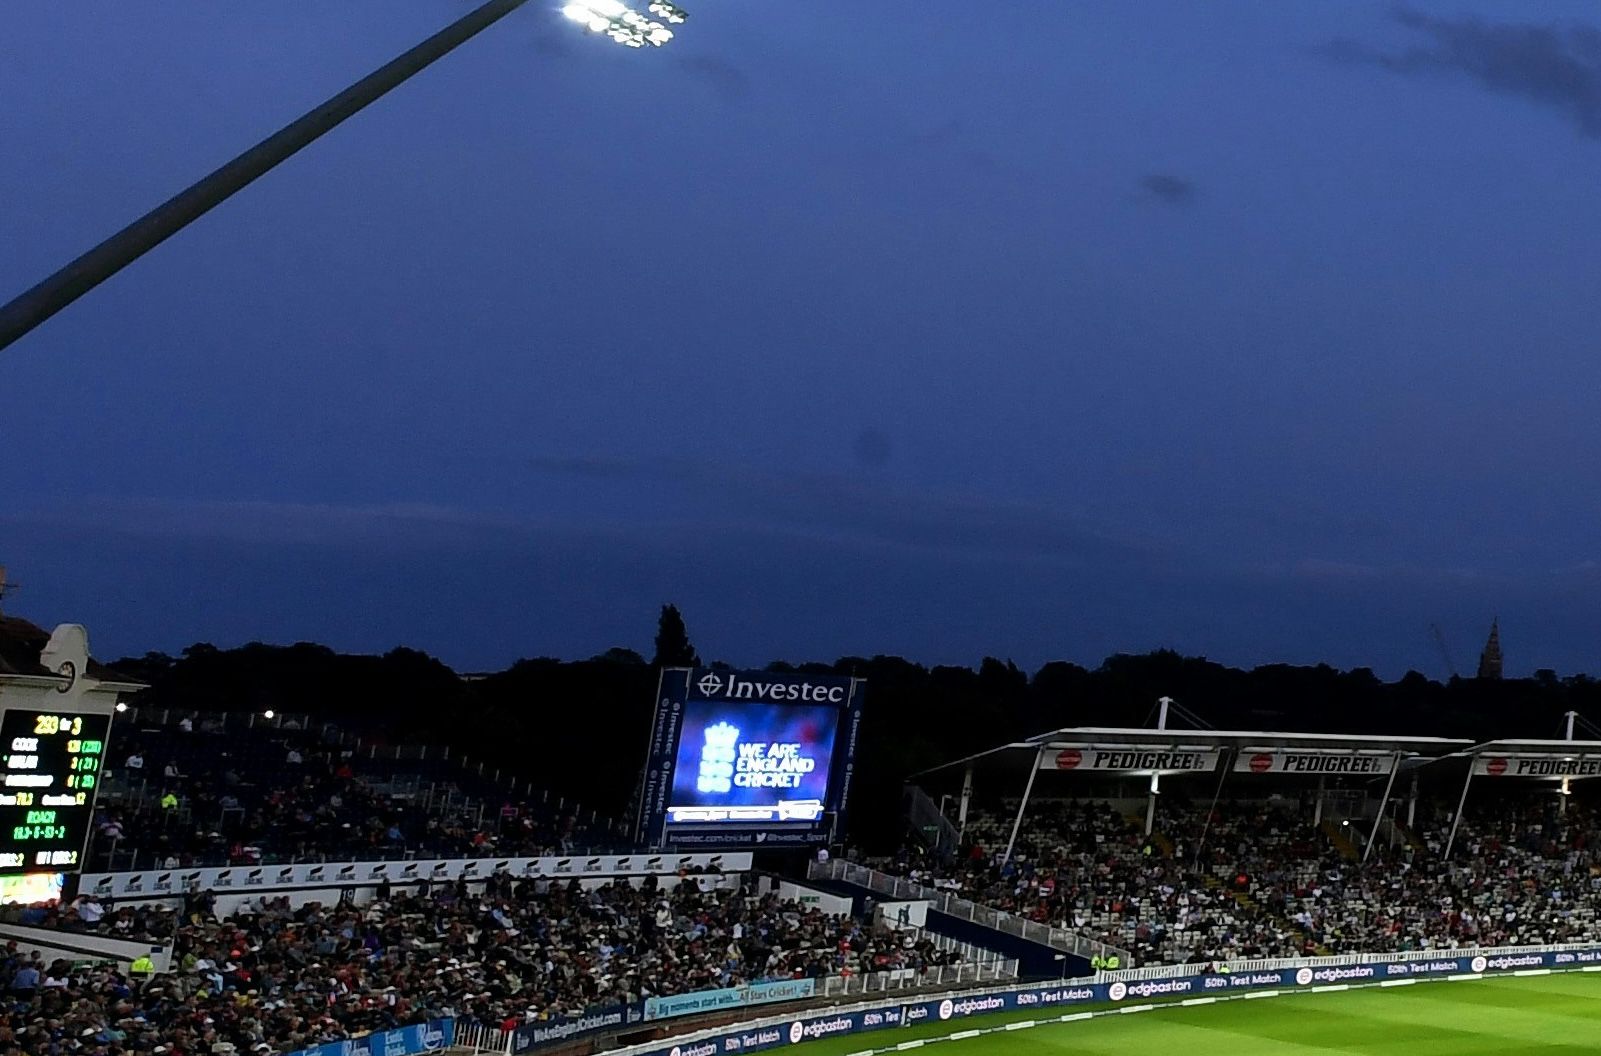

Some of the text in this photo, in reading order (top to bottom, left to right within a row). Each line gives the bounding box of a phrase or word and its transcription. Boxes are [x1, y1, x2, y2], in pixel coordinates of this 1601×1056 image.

[725, 674, 843, 702] Investec
[34, 716, 59, 734] 293
[71, 716, 82, 735] 3
[739, 743, 801, 758] WE ARE
[736, 757, 815, 773] ENGLAND
[1093, 752, 1192, 769] PEDIGREE
[1282, 754, 1370, 771] PEDIGREE
[1517, 760, 1597, 775] PEDIGREE
[733, 773, 804, 788] CRICKET
[1410, 963, 1428, 973] Test
[1429, 961, 1458, 972] Match
[1488, 954, 1542, 969] edgbaston
[1230, 976, 1249, 986] Test
[1251, 973, 1281, 985] Match
[1314, 967, 1373, 981] edgbaston
[1129, 979, 1191, 996] edgbaston
[750, 991, 767, 1000] Stars
[1041, 992, 1059, 1003] Test
[1061, 989, 1093, 1001] Match
[954, 997, 1003, 1014] edgbaston
[804, 1017, 852, 1037] edgbaston
[742, 1033, 758, 1048] Test
[758, 1030, 780, 1045] Match
